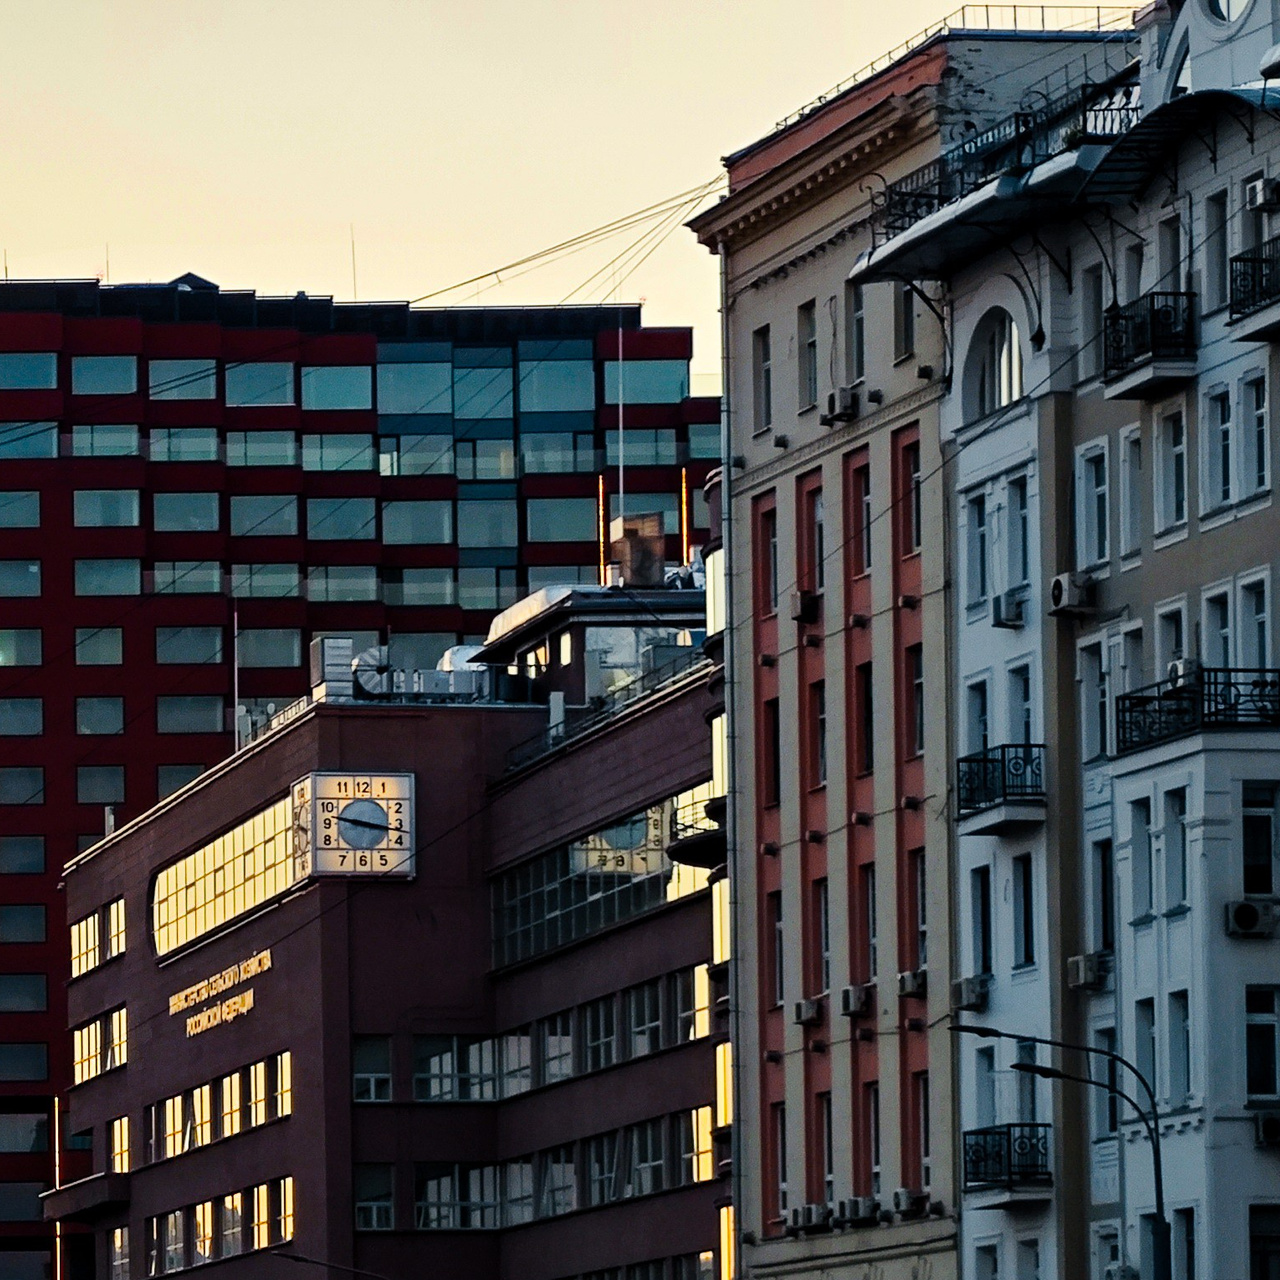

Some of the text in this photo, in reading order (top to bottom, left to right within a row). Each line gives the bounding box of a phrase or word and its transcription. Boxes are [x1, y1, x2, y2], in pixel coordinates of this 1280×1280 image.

[337, 782, 386, 793] 11 12 1
[321, 802, 334, 813] 10
[394, 802, 403, 814] 2
[323, 818, 331, 830] 9
[394, 819, 403, 830] 3
[323, 834, 331, 846] 8
[394, 834, 403, 846] 4
[339, 854, 388, 867] 7 6 5
